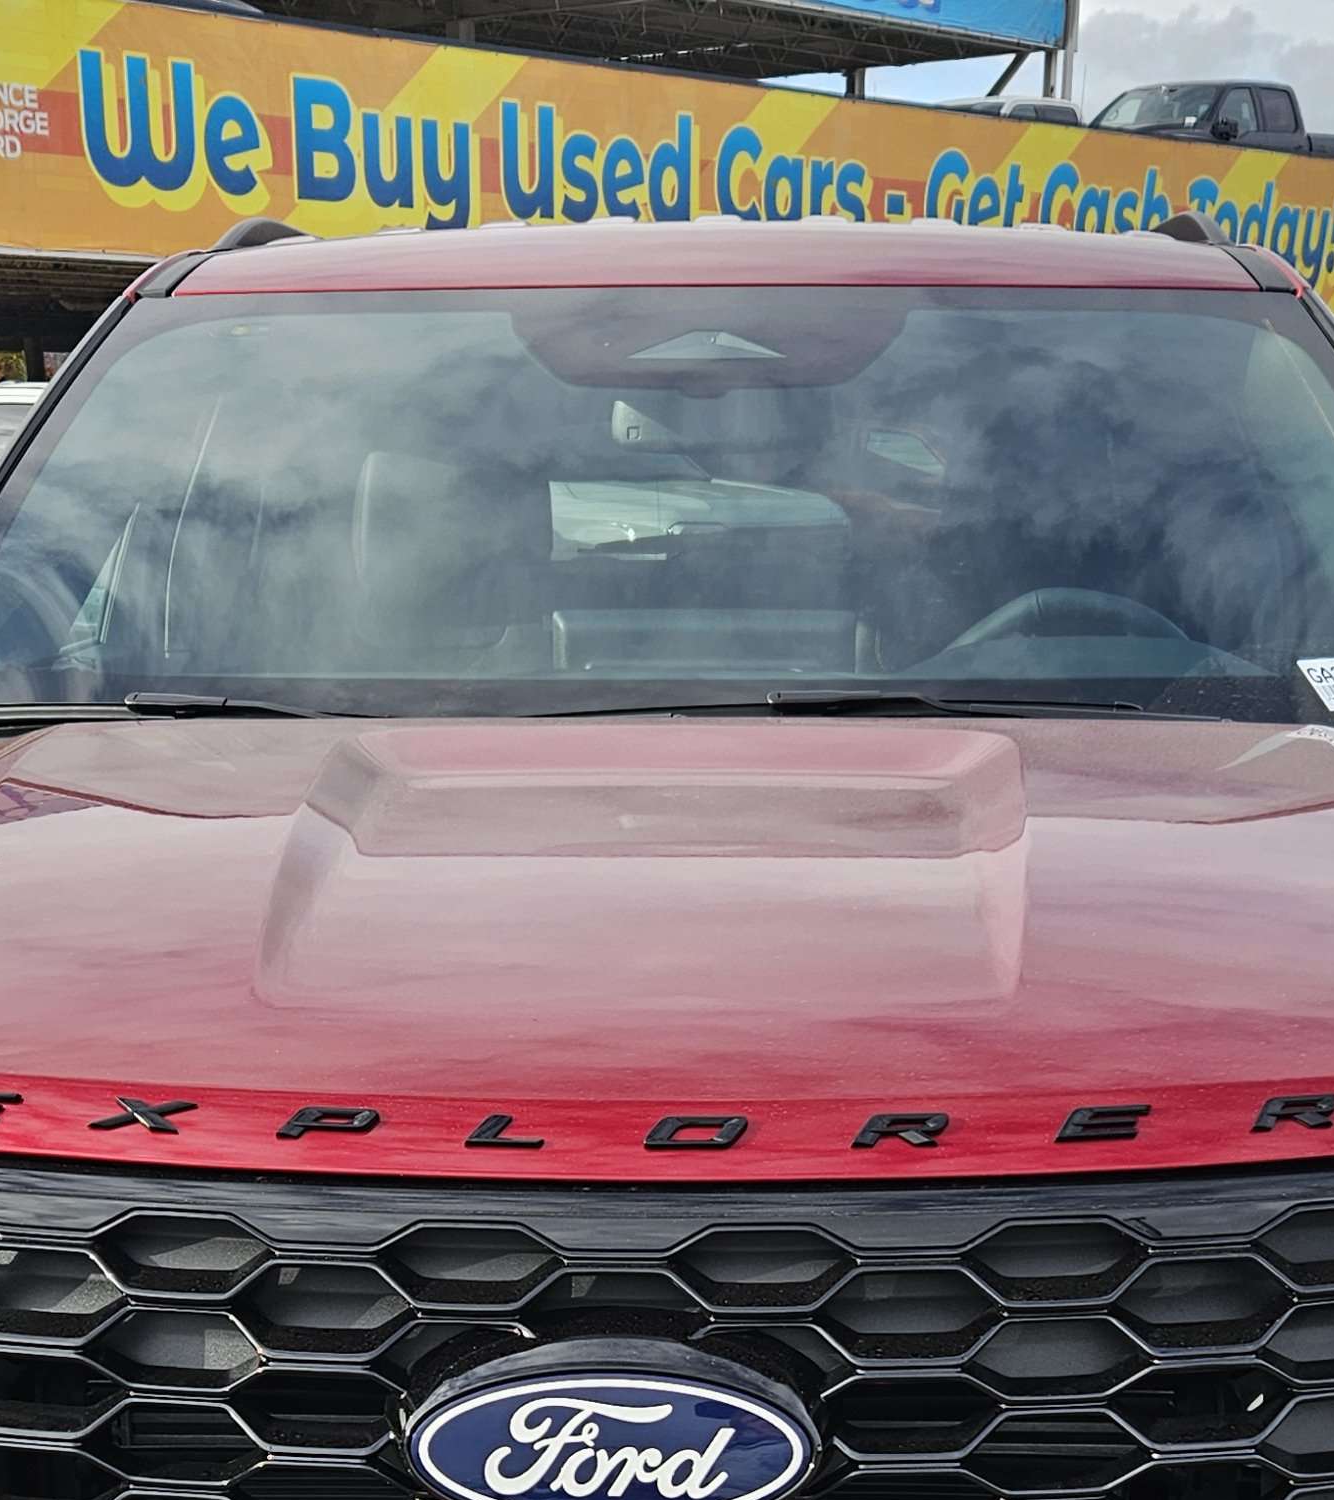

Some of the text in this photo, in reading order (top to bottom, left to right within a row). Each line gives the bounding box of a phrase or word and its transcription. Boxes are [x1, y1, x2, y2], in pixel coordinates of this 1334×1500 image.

[78, 48, 261, 196] We
[292, 76, 470, 230] Buy
[500, 100, 693, 222] Used
[716, 124, 866, 223] Cars
[926, 149, 1024, 227] Get
[1041, 162, 1171, 234] Cash
[483, 1396, 736, 1500] Ford
